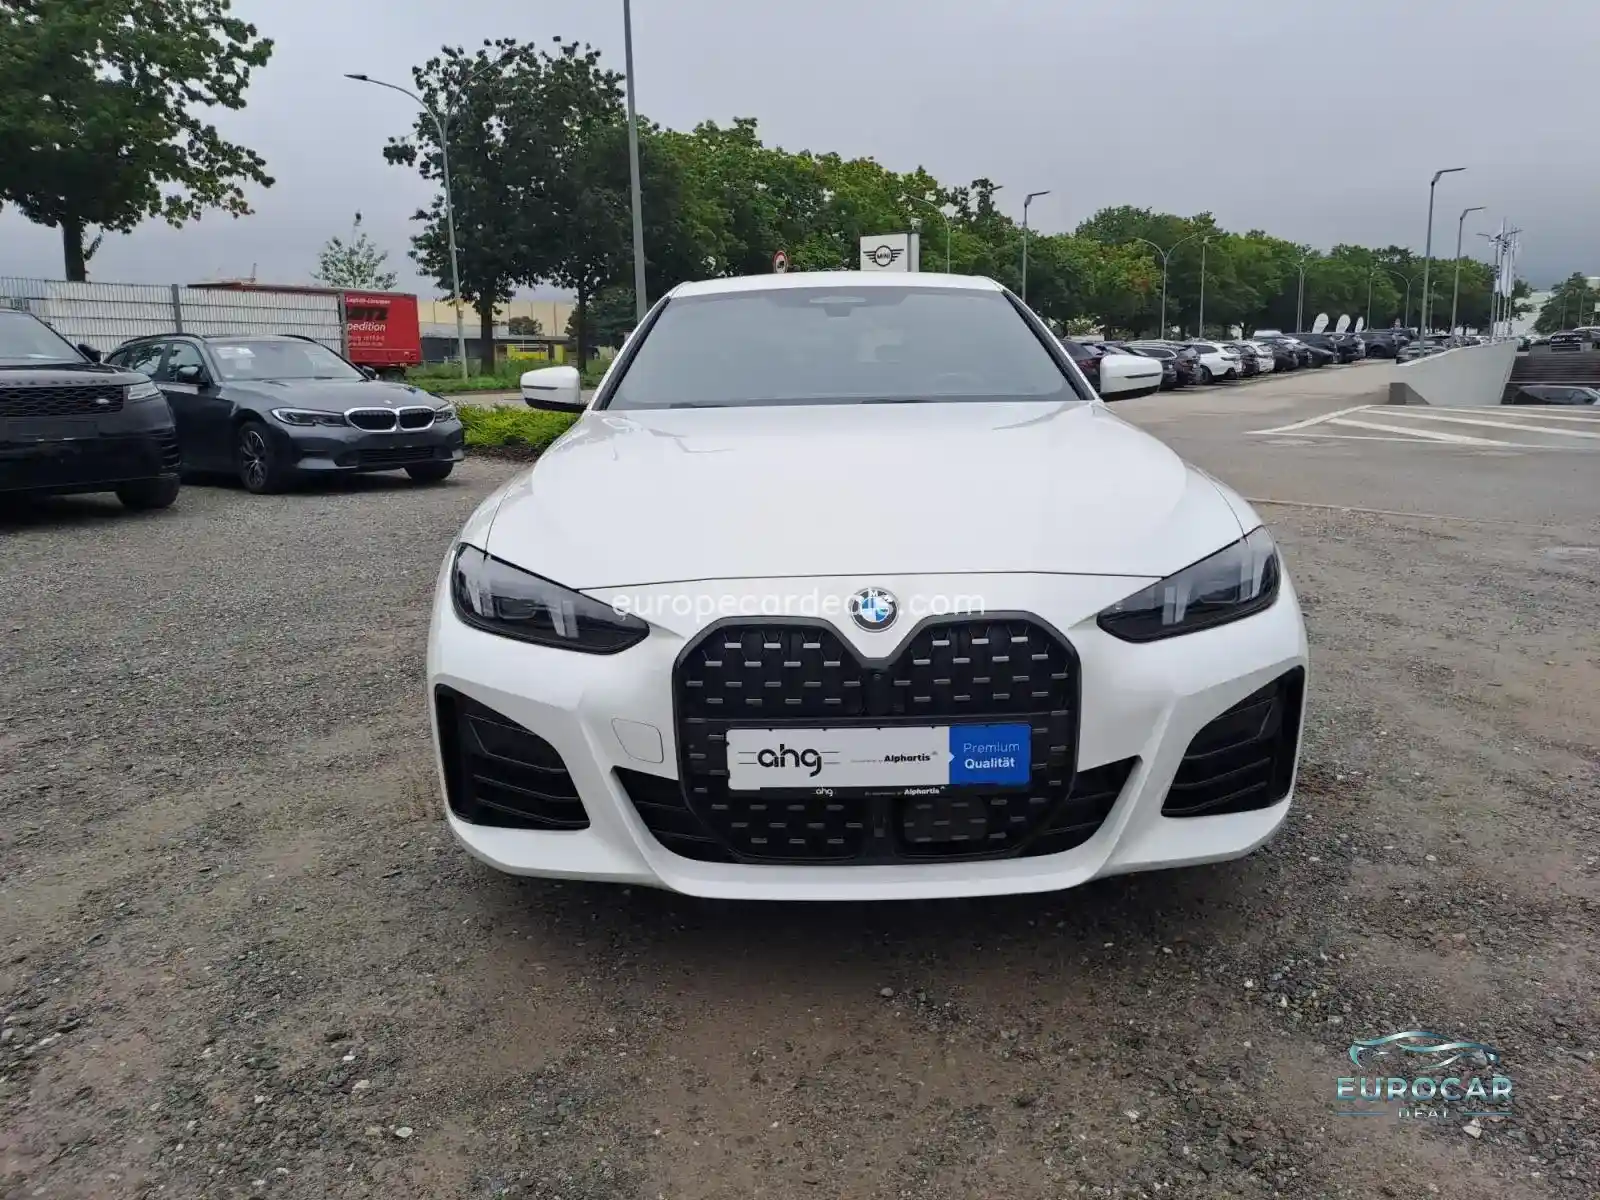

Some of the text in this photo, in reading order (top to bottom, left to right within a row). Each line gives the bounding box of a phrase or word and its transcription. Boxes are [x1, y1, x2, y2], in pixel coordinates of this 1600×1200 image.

[347, 321, 386, 331] pedition
[963, 742, 1020, 754] Premium
[757, 743, 822, 778] ahg
[884, 753, 931, 764] Alphartis
[964, 757, 1016, 769] Qualität
[815, 786, 834, 797] ahg
